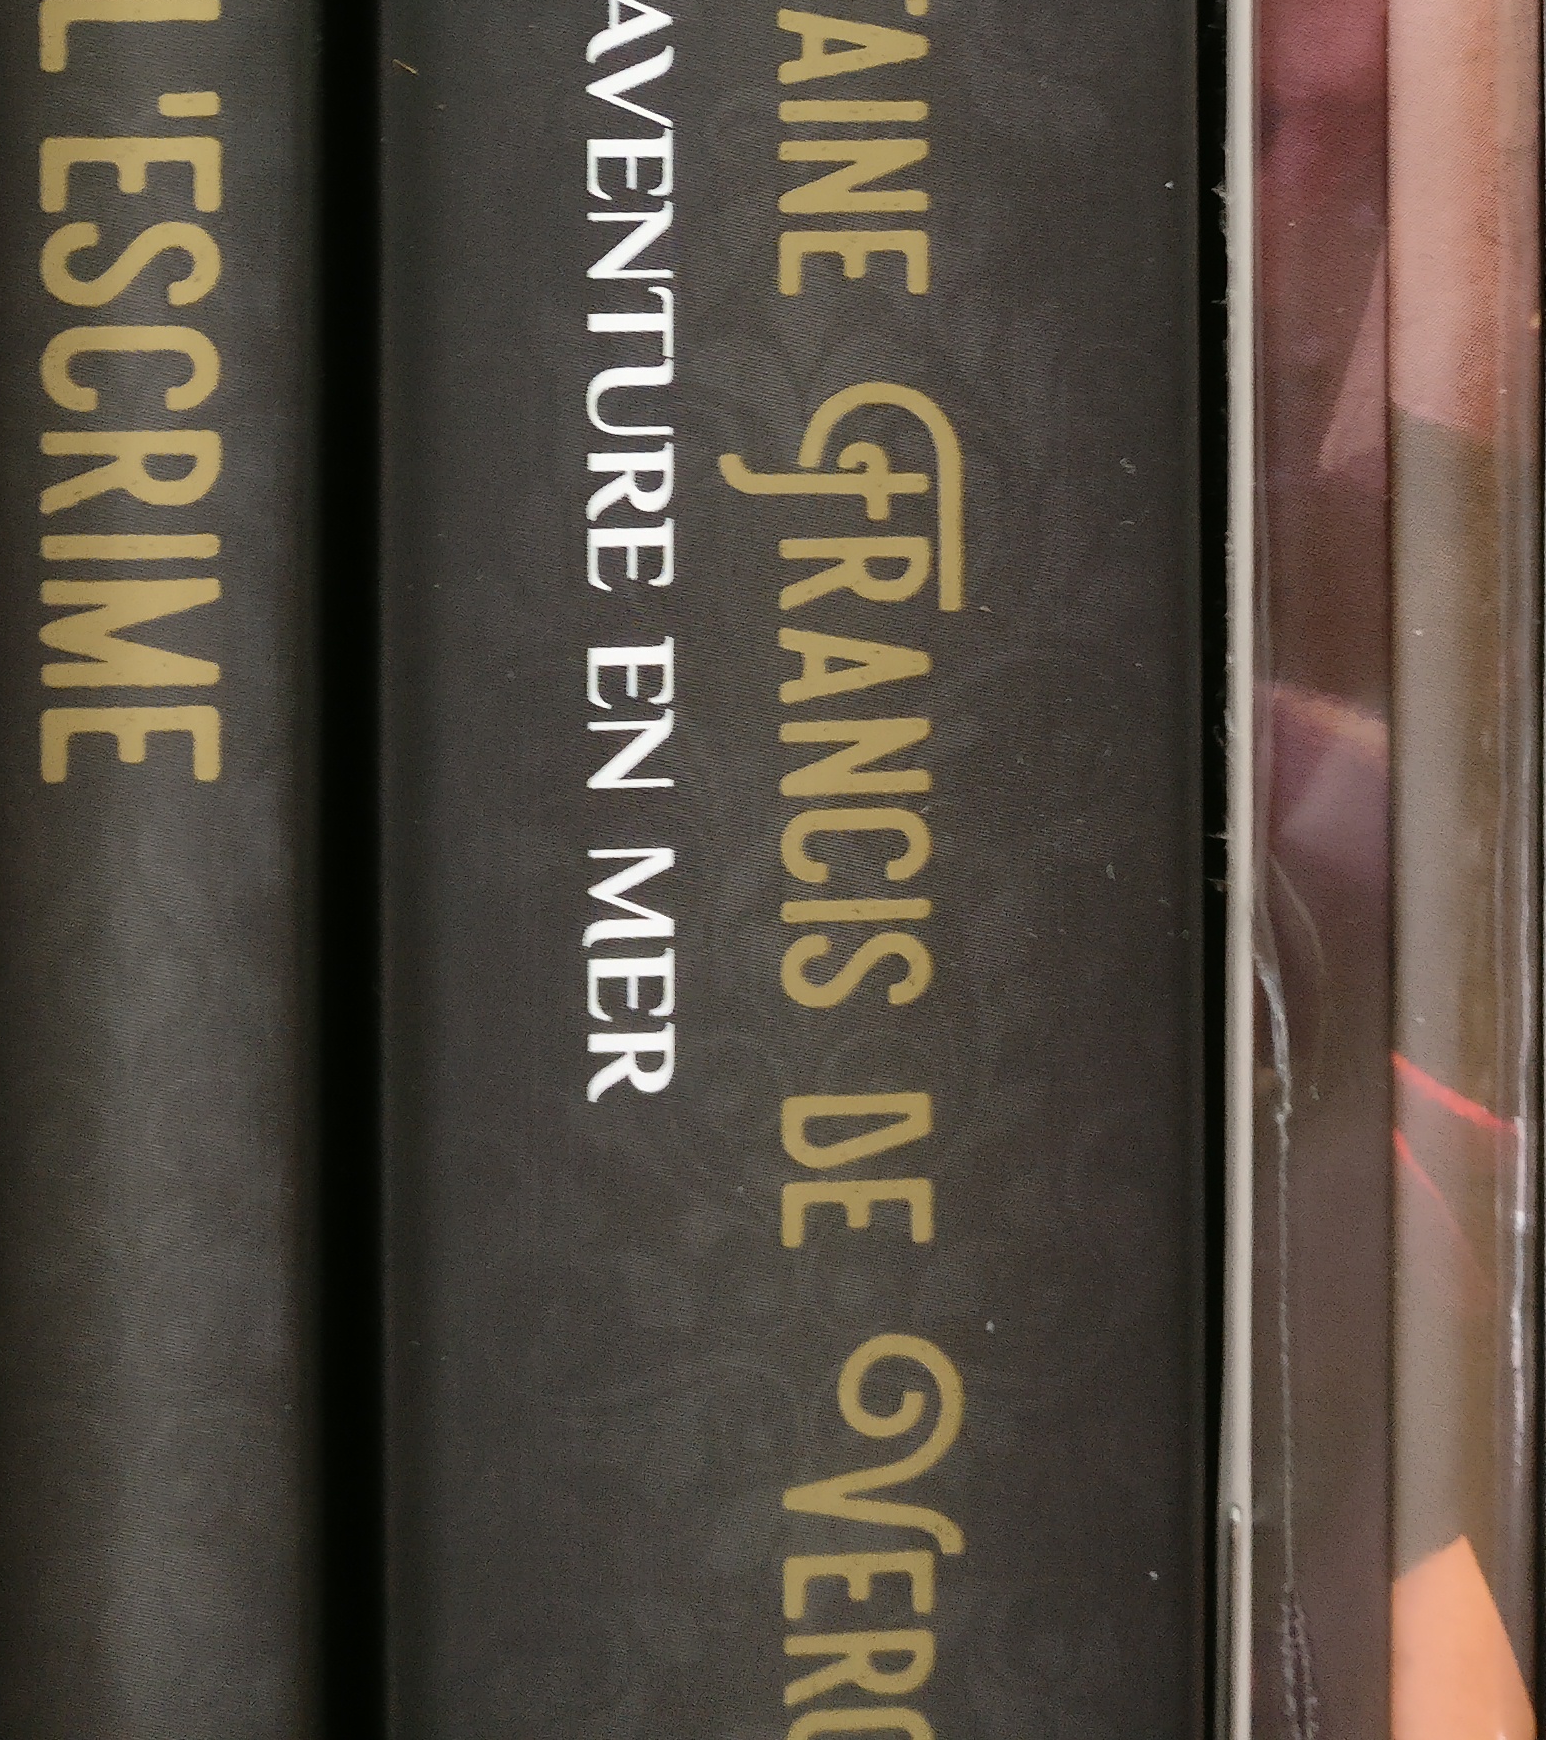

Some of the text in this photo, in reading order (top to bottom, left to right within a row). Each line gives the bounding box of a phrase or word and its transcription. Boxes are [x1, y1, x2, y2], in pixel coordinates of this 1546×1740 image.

[585, 635, 676, 791] EN
[718, 380, 967, 1010] FRANCIS
[581, 846, 677, 1104] MER
[779, 1089, 936, 1250] DE
